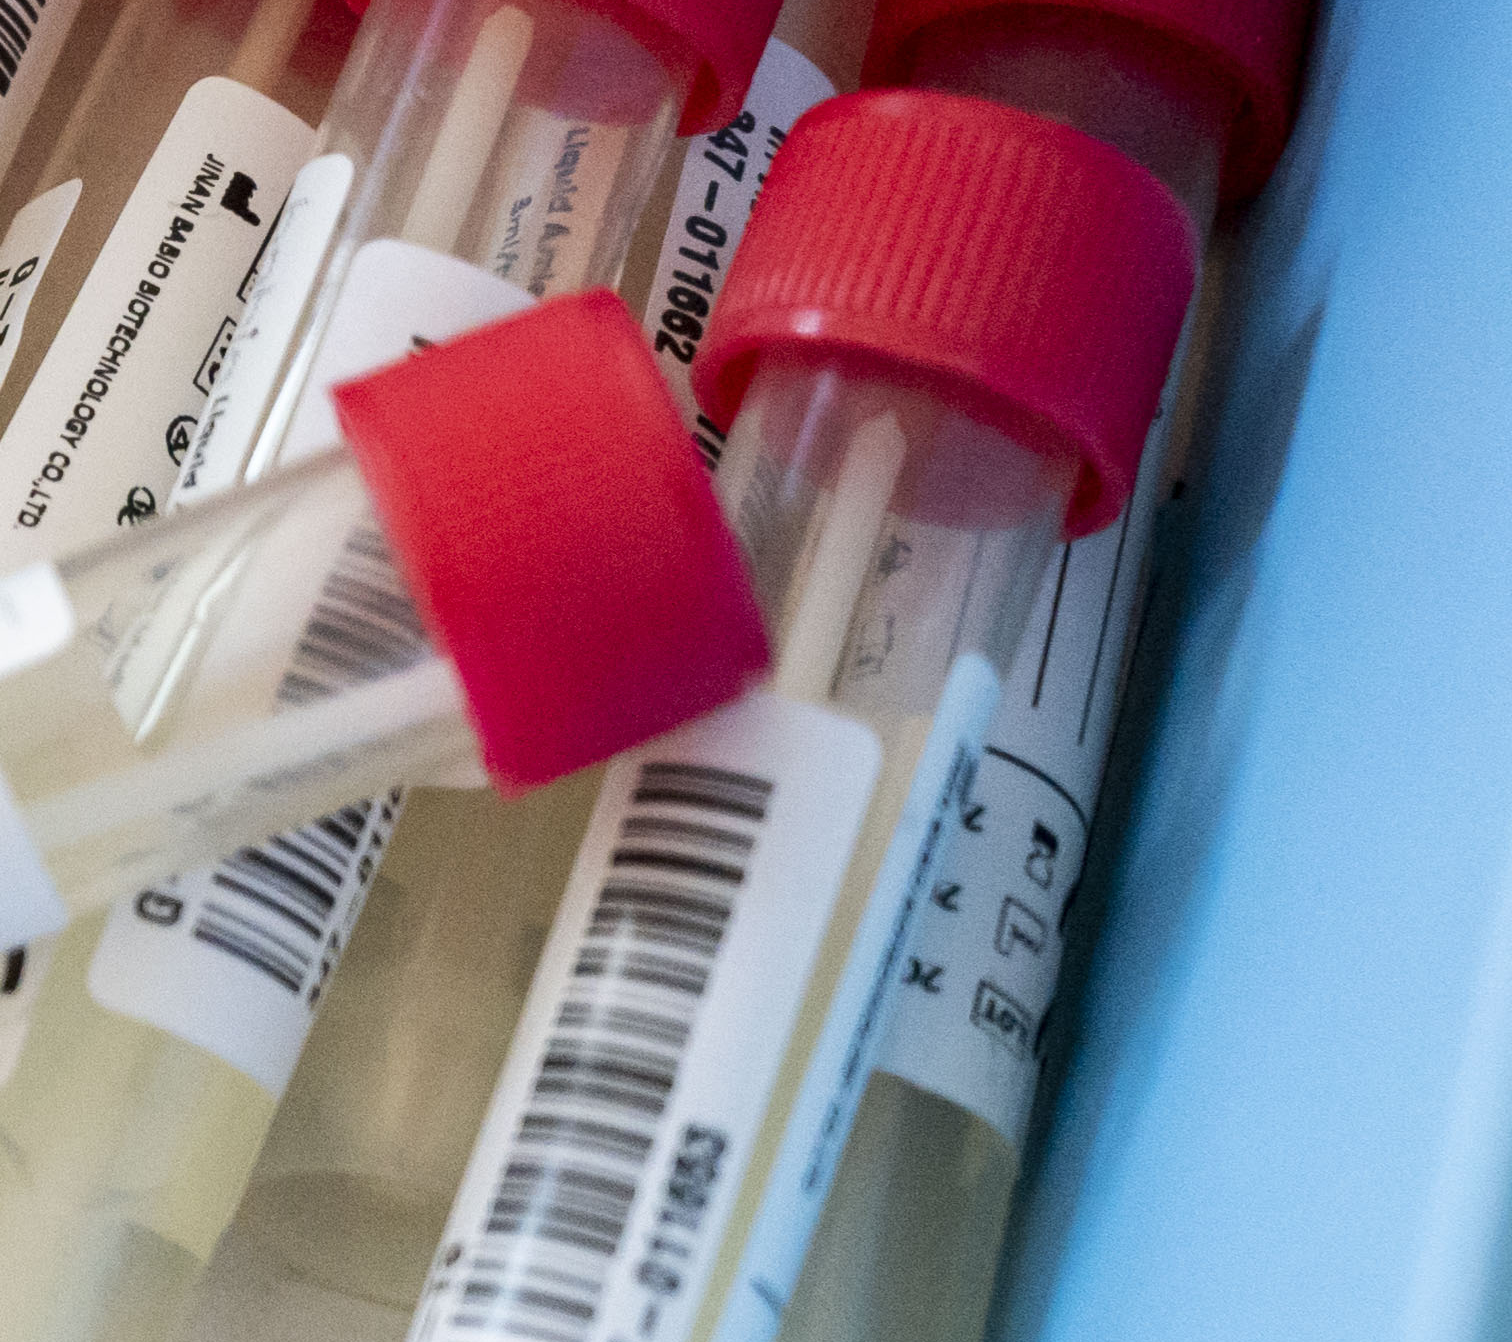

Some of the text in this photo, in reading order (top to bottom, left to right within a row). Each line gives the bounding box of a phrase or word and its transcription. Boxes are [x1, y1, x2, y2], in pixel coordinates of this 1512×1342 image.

[180, 152, 225, 216] JINAN
[147, 215, 195, 280] BABIO
[62, 279, 162, 449] BIOTECHNOLOGY
